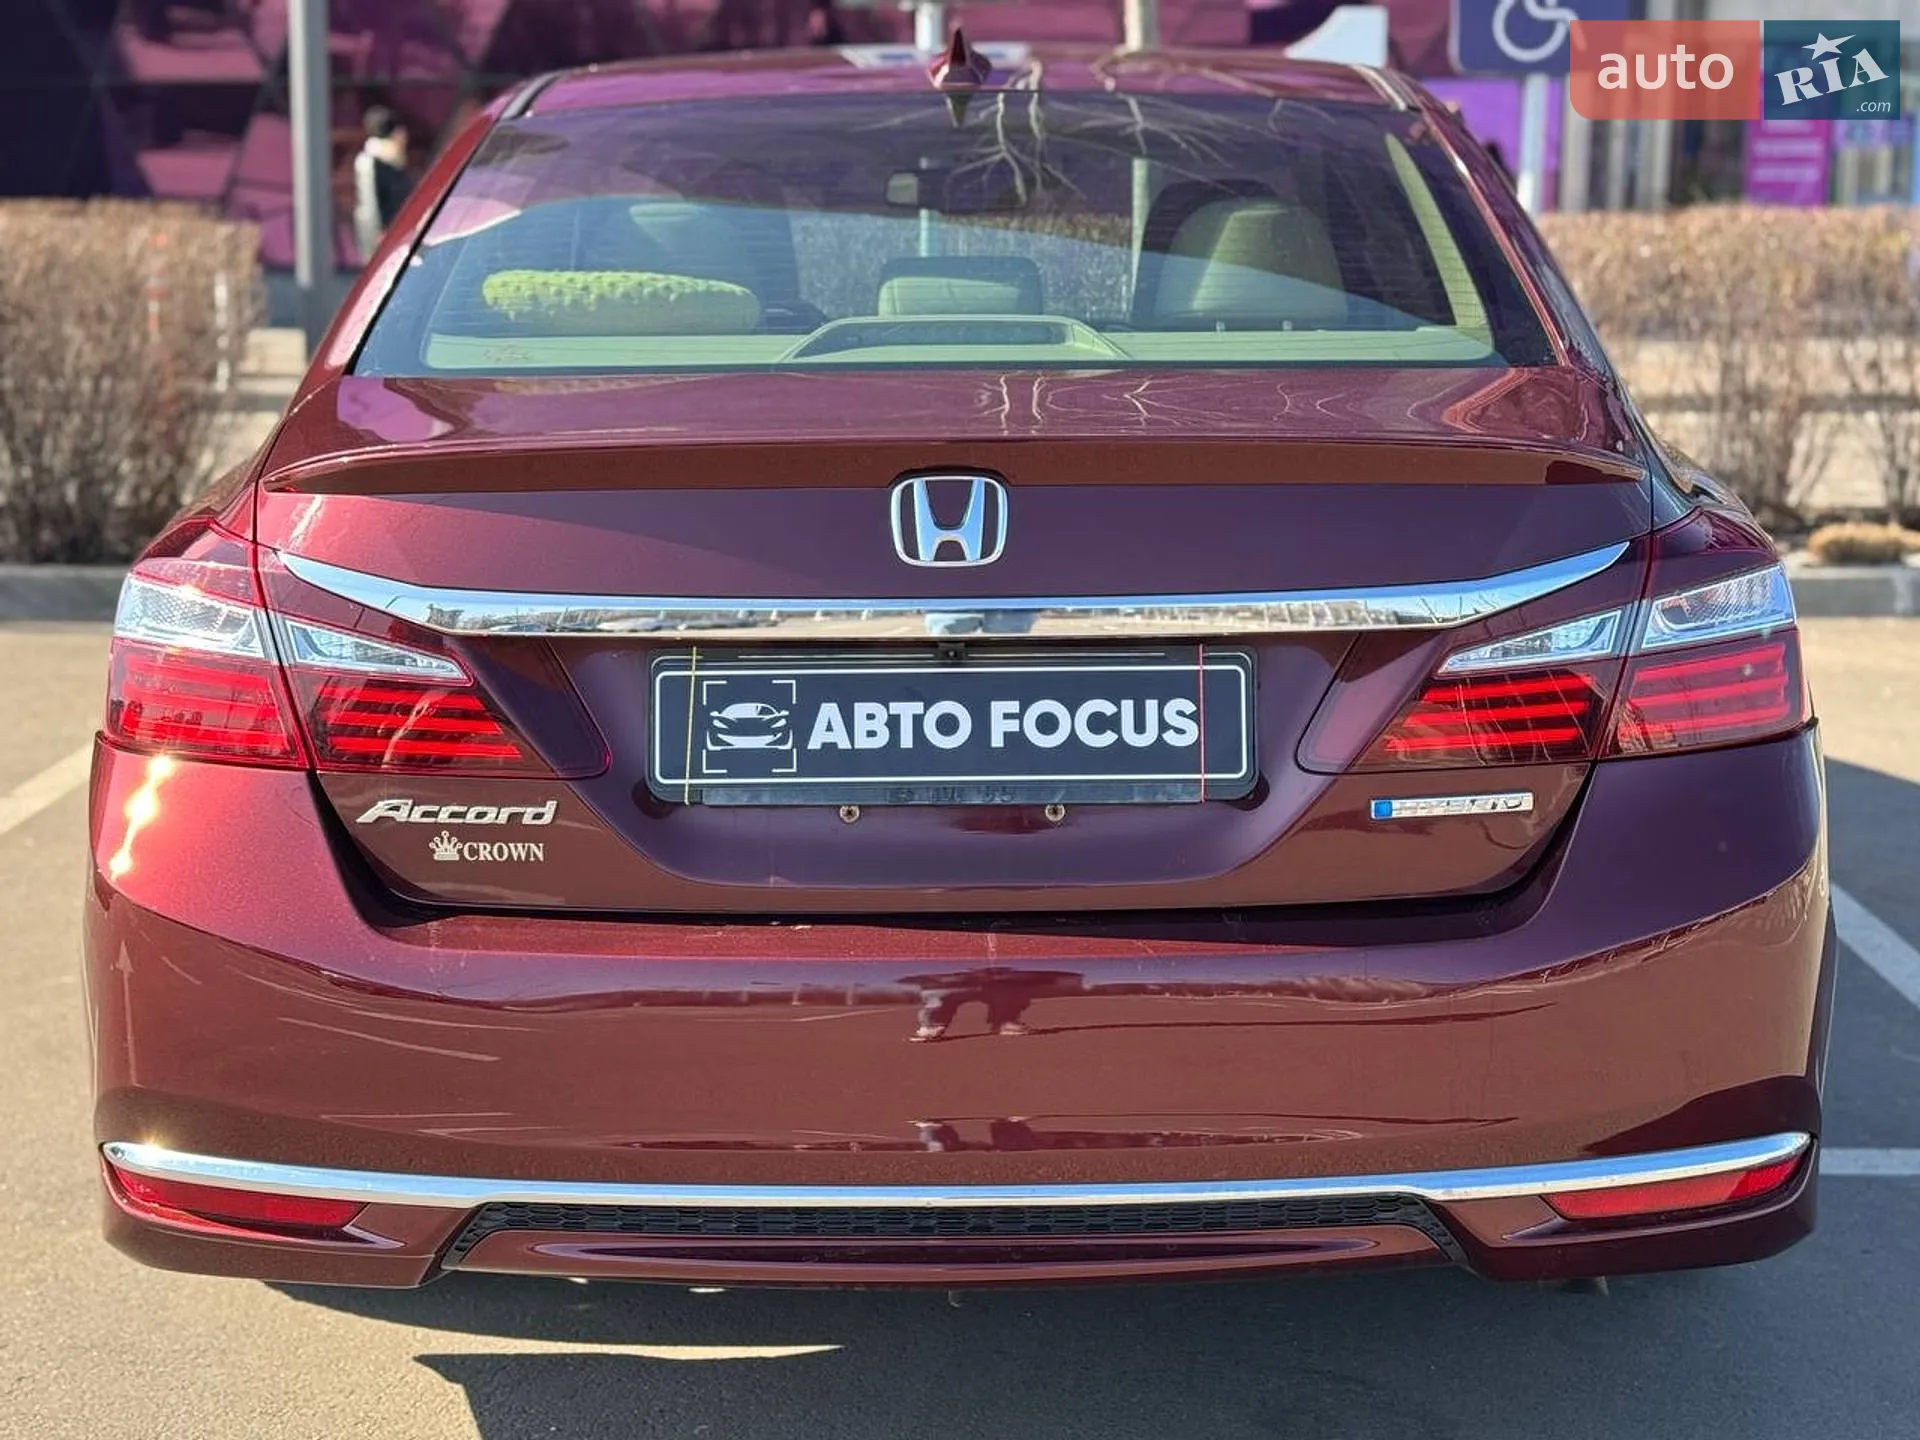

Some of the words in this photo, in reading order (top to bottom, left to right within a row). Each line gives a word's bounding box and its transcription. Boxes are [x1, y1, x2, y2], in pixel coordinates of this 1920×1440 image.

[807, 700, 971, 750] АВТО
[991, 698, 1200, 749] FOCUS
[356, 799, 558, 825] Accord
[463, 842, 545, 862] CROWN
